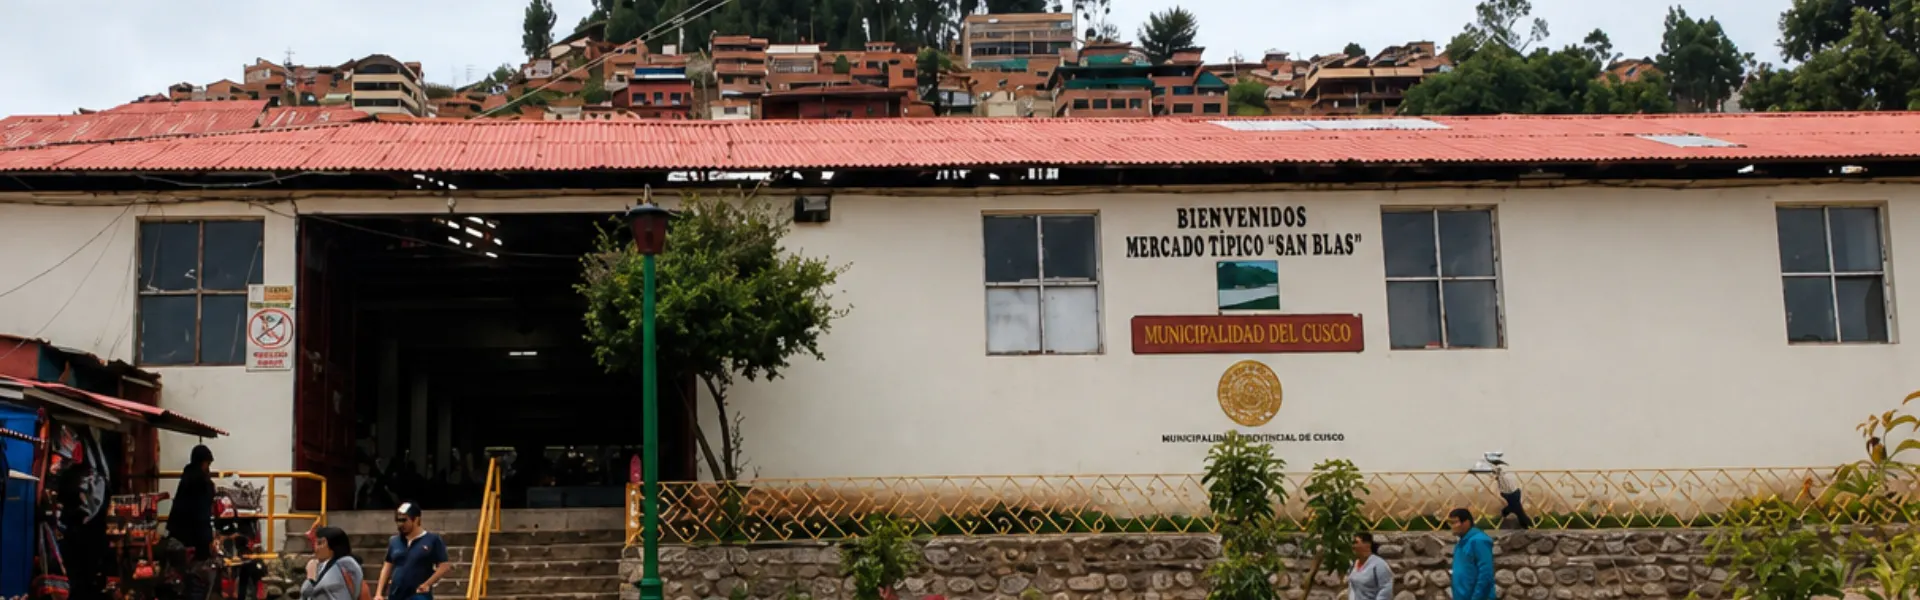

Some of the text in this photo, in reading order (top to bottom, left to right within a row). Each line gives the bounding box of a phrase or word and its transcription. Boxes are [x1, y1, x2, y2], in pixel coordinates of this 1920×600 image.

[1177, 206, 1306, 229] BIENVENIDOS
[1126, 235, 1204, 258] MERCADO
[1209, 230, 1263, 257] TÍPICO
[1145, 323, 1351, 344] MUNICIPALIDAD DEL CUSCO
[1299, 433, 1312, 441] DE
[1313, 433, 1345, 441] CUSCO
